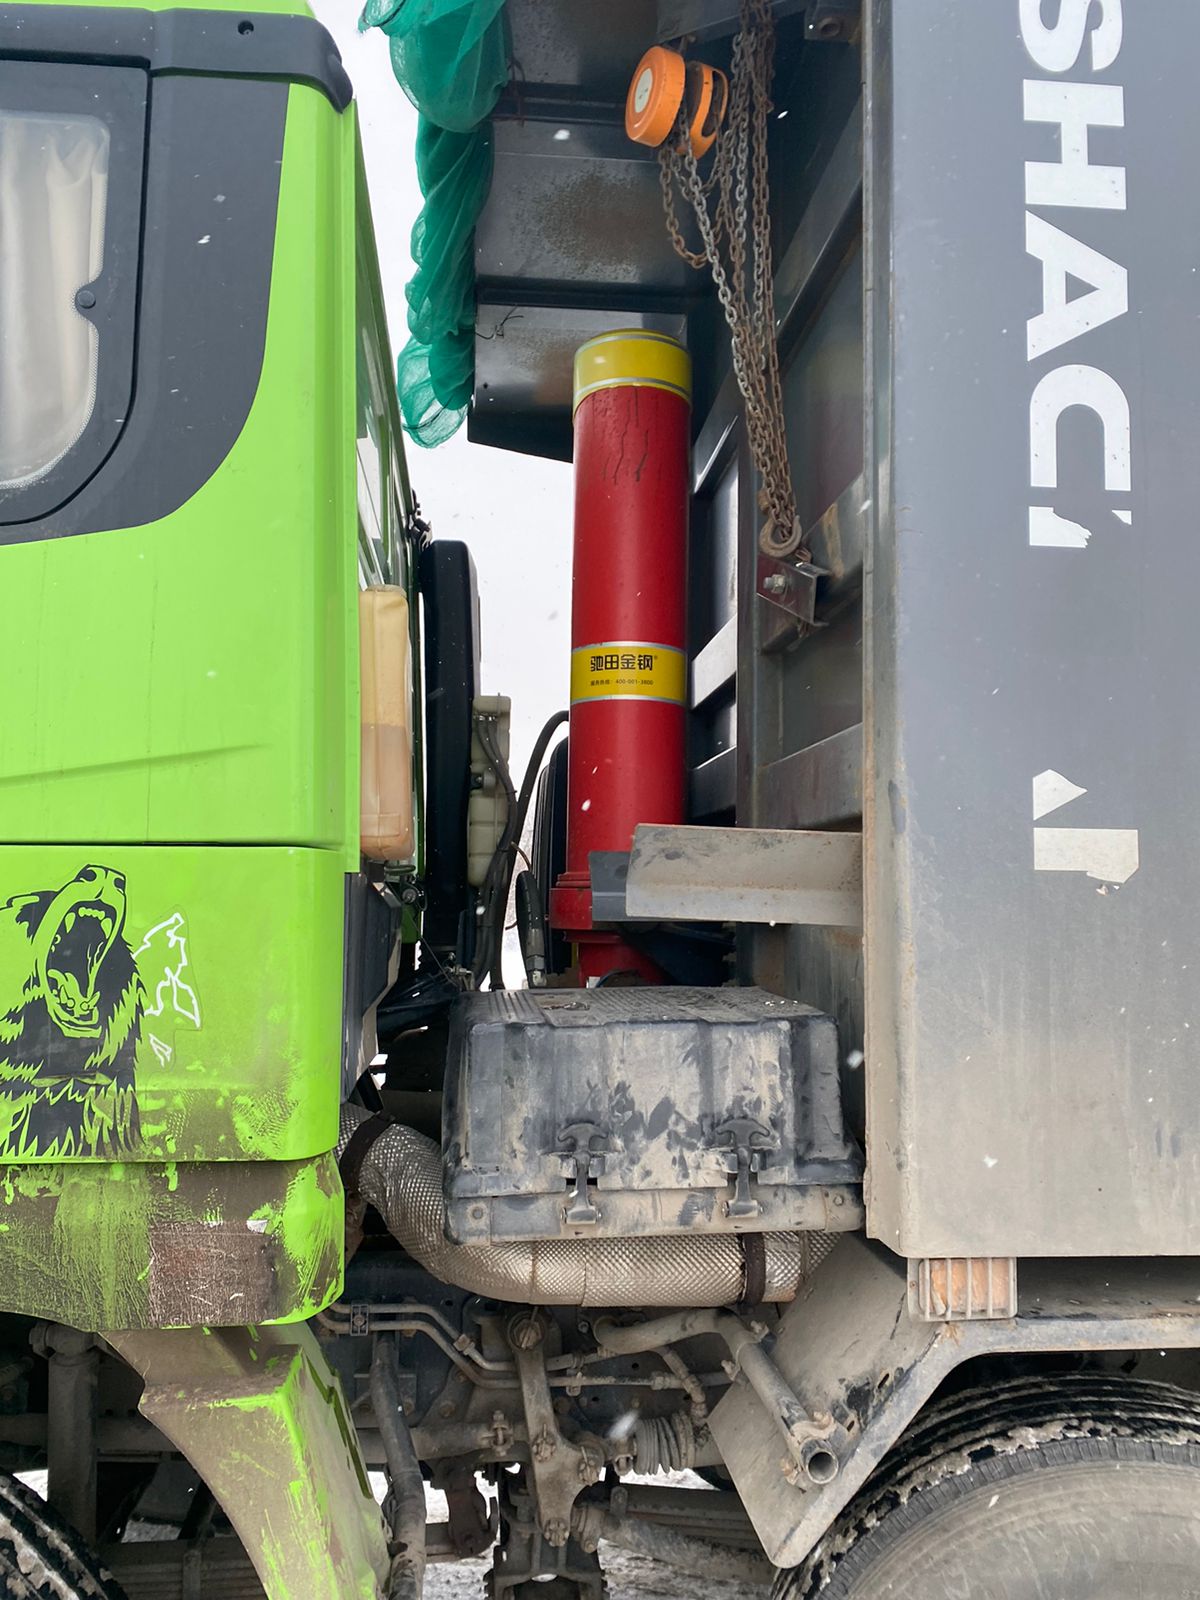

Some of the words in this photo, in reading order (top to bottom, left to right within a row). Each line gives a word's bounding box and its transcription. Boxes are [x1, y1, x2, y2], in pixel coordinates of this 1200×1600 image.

[590, 654, 653, 672] 驰田金钢
[1018, 0, 1138, 884] SHAC
